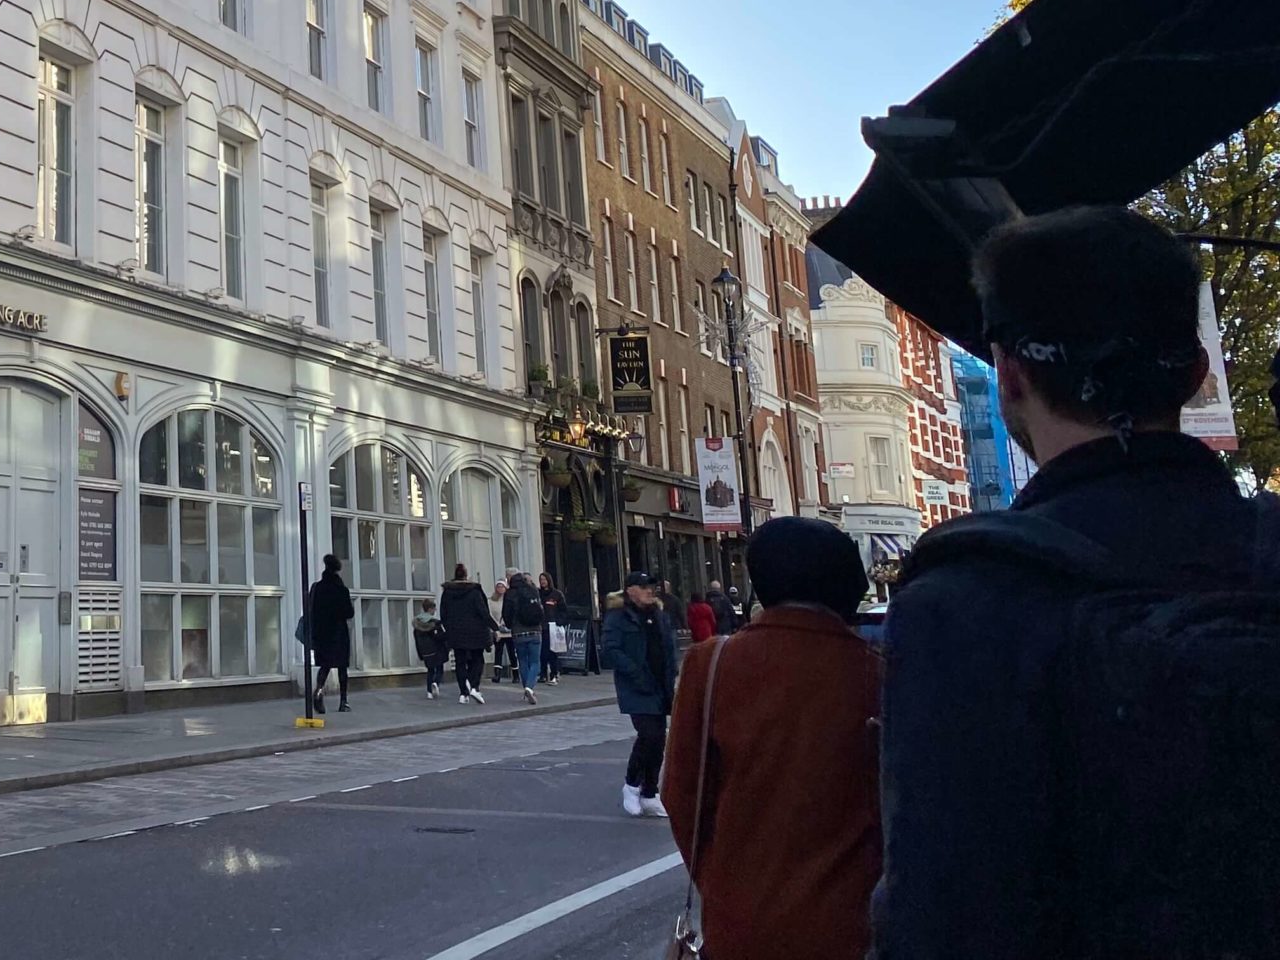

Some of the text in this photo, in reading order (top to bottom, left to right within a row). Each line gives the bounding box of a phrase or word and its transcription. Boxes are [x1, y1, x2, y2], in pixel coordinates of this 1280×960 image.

[17, 310, 48, 332] ACRE
[618, 349, 640, 359] SUN
[617, 361, 644, 369] TAVERN
